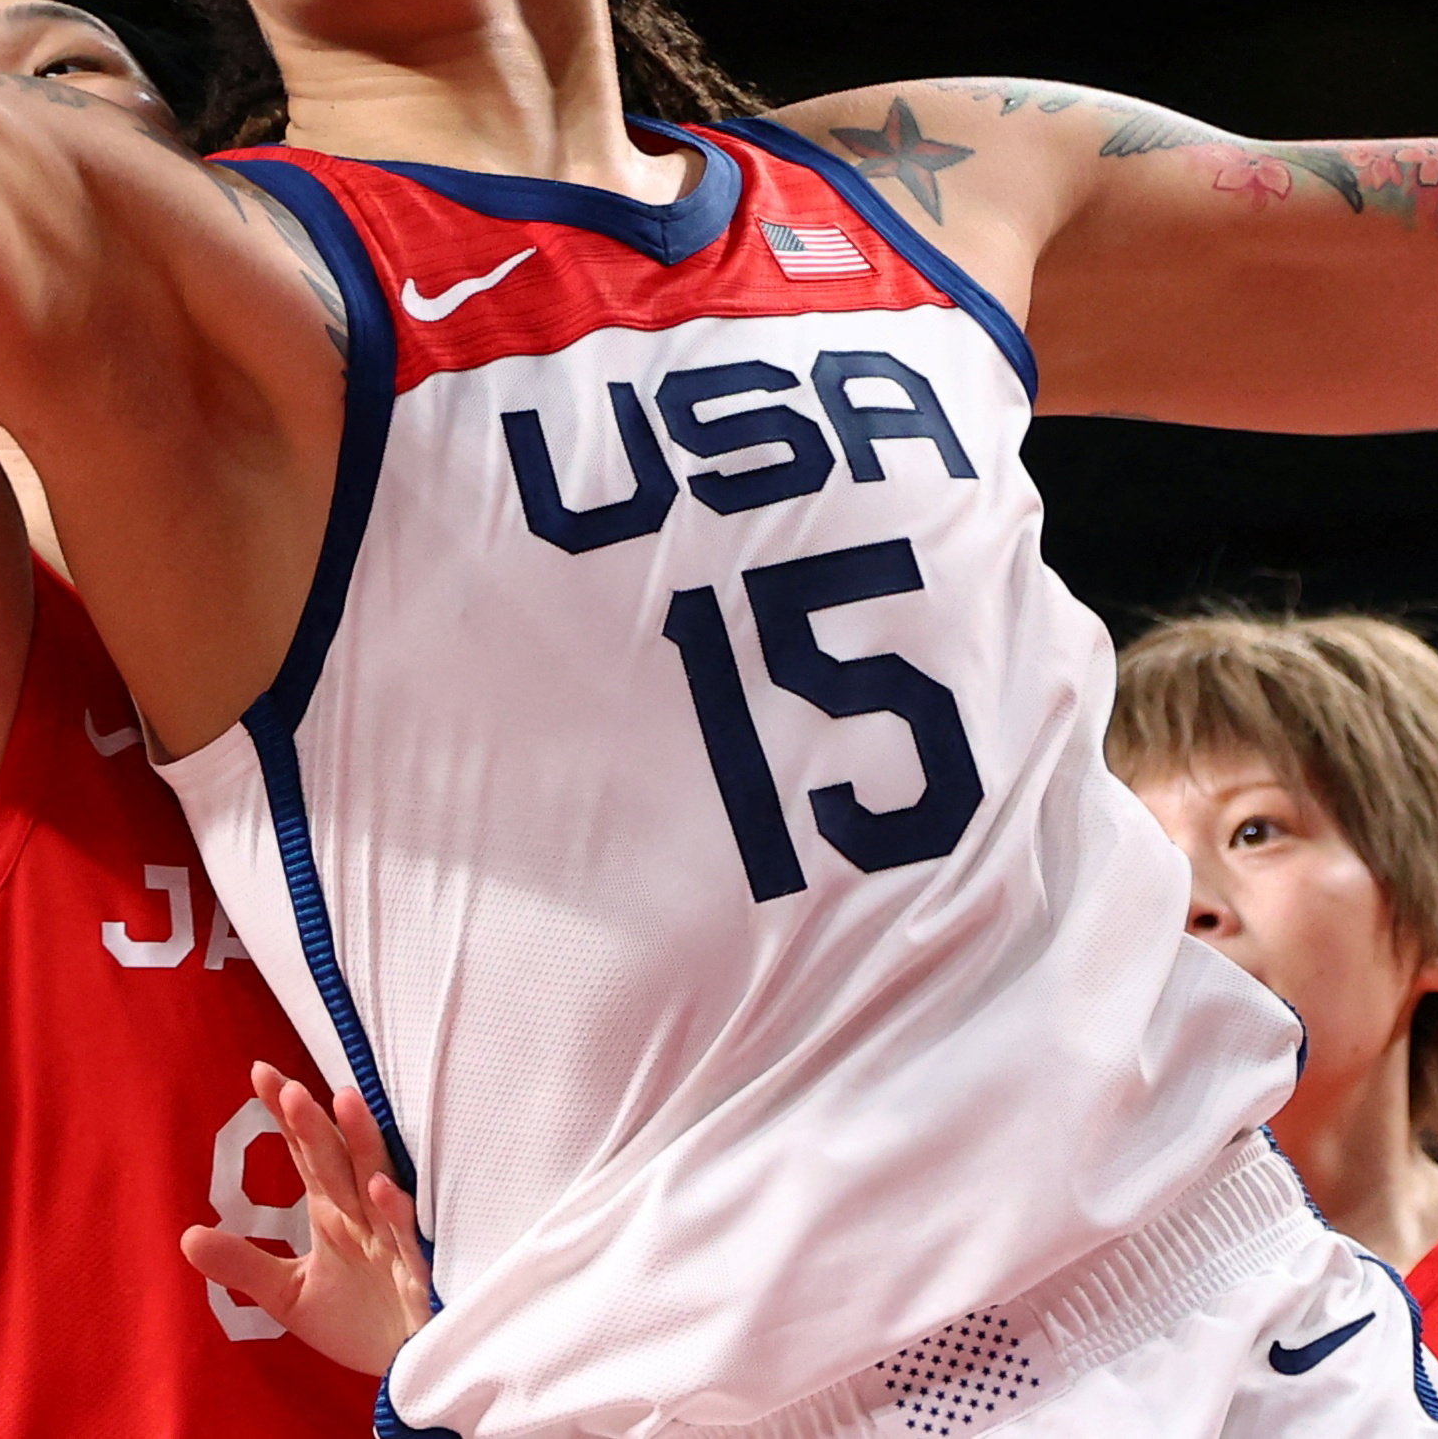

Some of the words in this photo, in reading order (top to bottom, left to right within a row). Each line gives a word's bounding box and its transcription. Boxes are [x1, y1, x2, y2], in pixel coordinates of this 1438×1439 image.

[499, 349, 980, 556] USA
[661, 537, 985, 904] 15
[208, 1096, 311, 1343] 8
